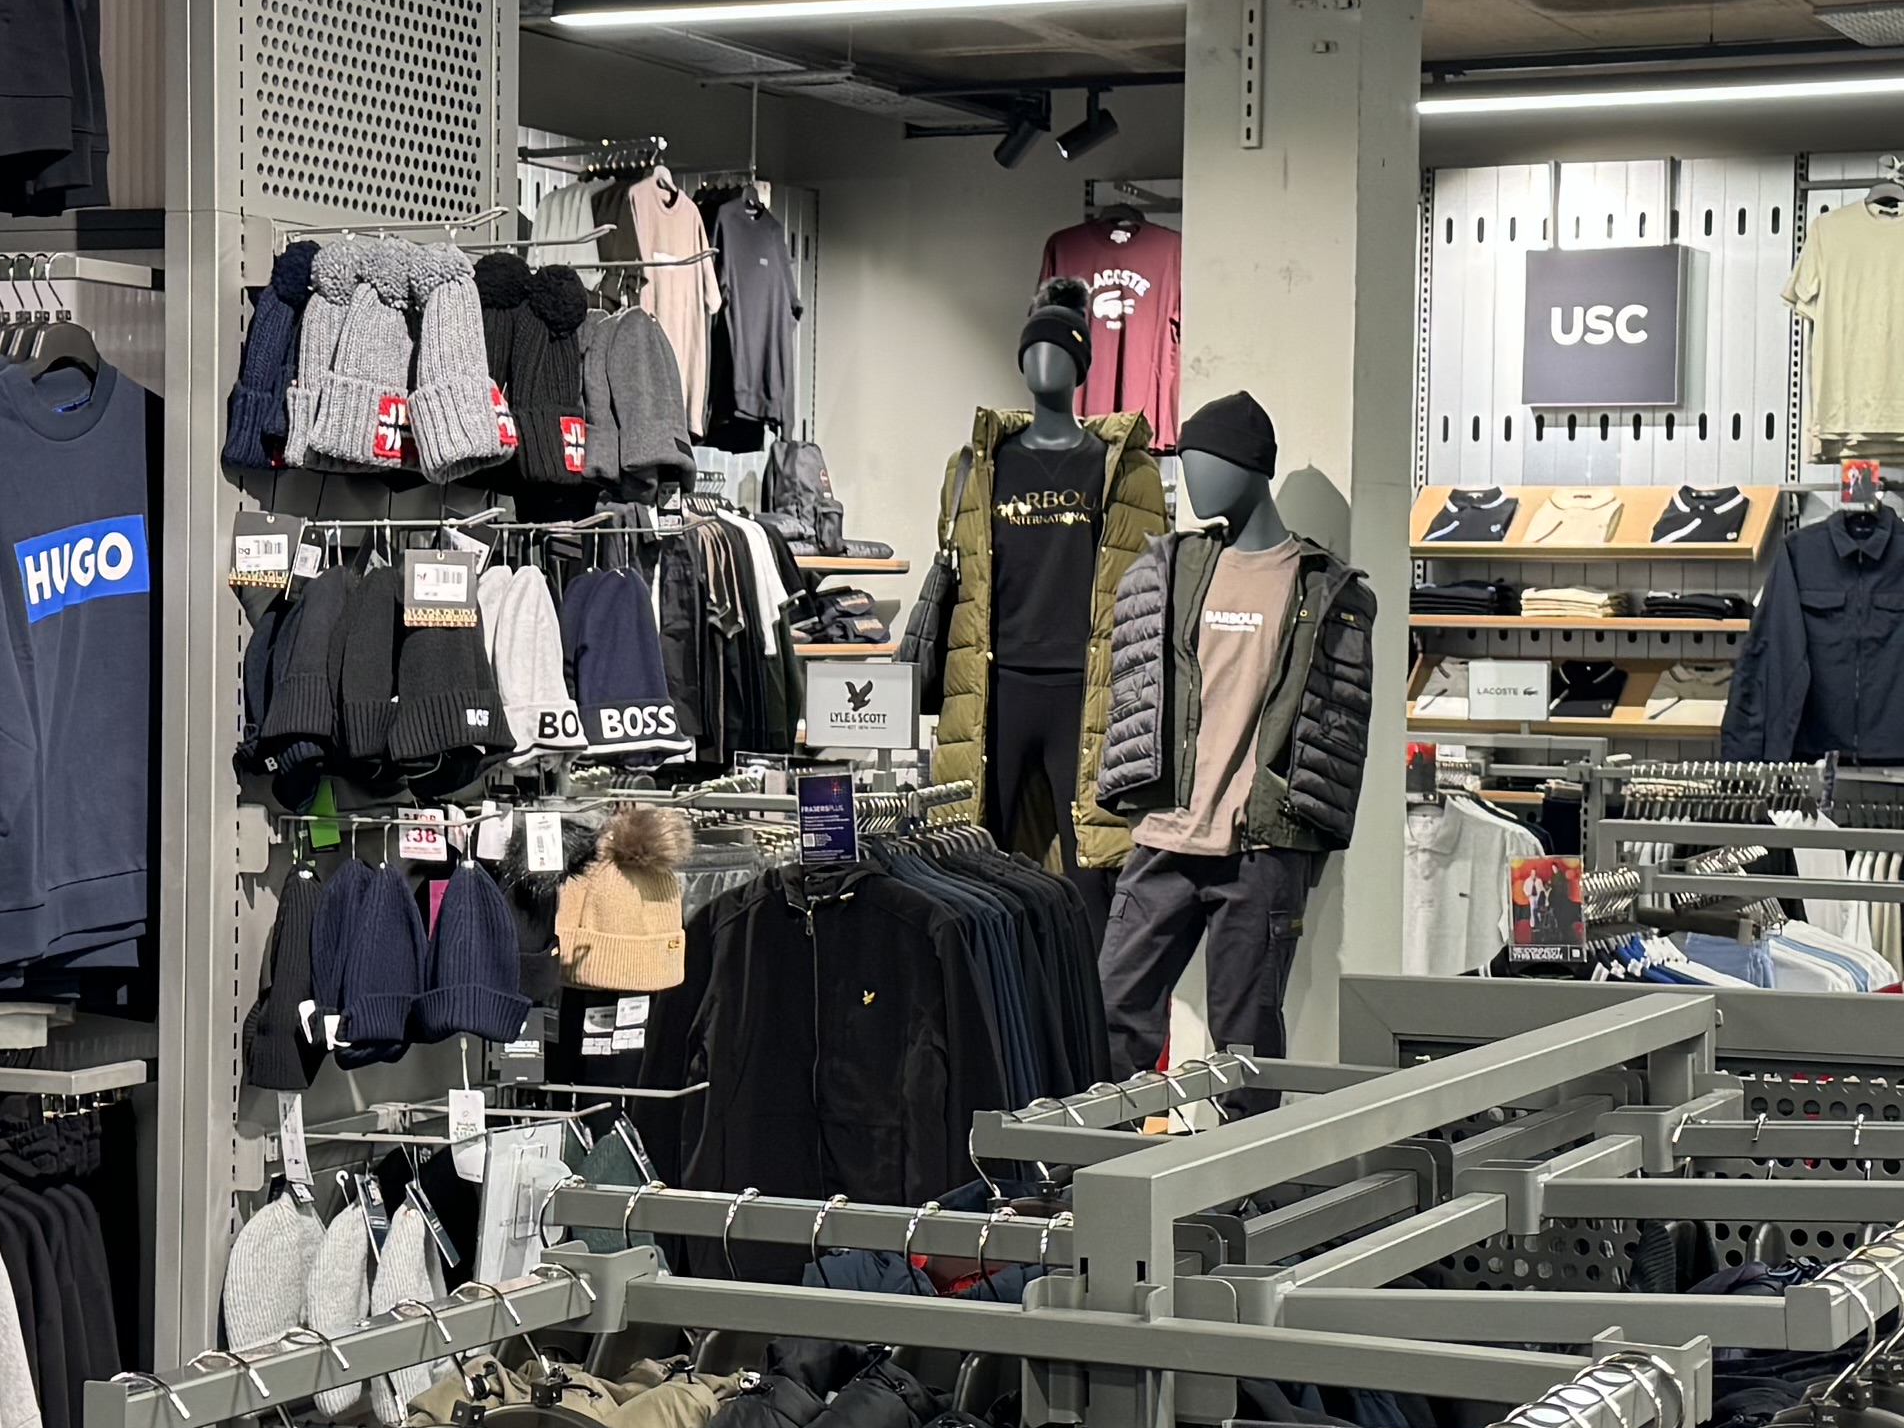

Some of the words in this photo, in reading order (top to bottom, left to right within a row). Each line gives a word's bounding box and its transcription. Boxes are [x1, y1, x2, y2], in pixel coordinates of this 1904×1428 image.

[1551, 304, 1648, 345] USC
[995, 488, 1098, 517] ARBOU
[25, 532, 133, 604] HUGO
[1205, 610, 1264, 625] BARBOUR
[1477, 687, 1519, 696] LACOSTE
[599, 705, 677, 740] BOSS
[830, 712, 851, 723] LYLE
[858, 713, 887, 724] SCOTT
